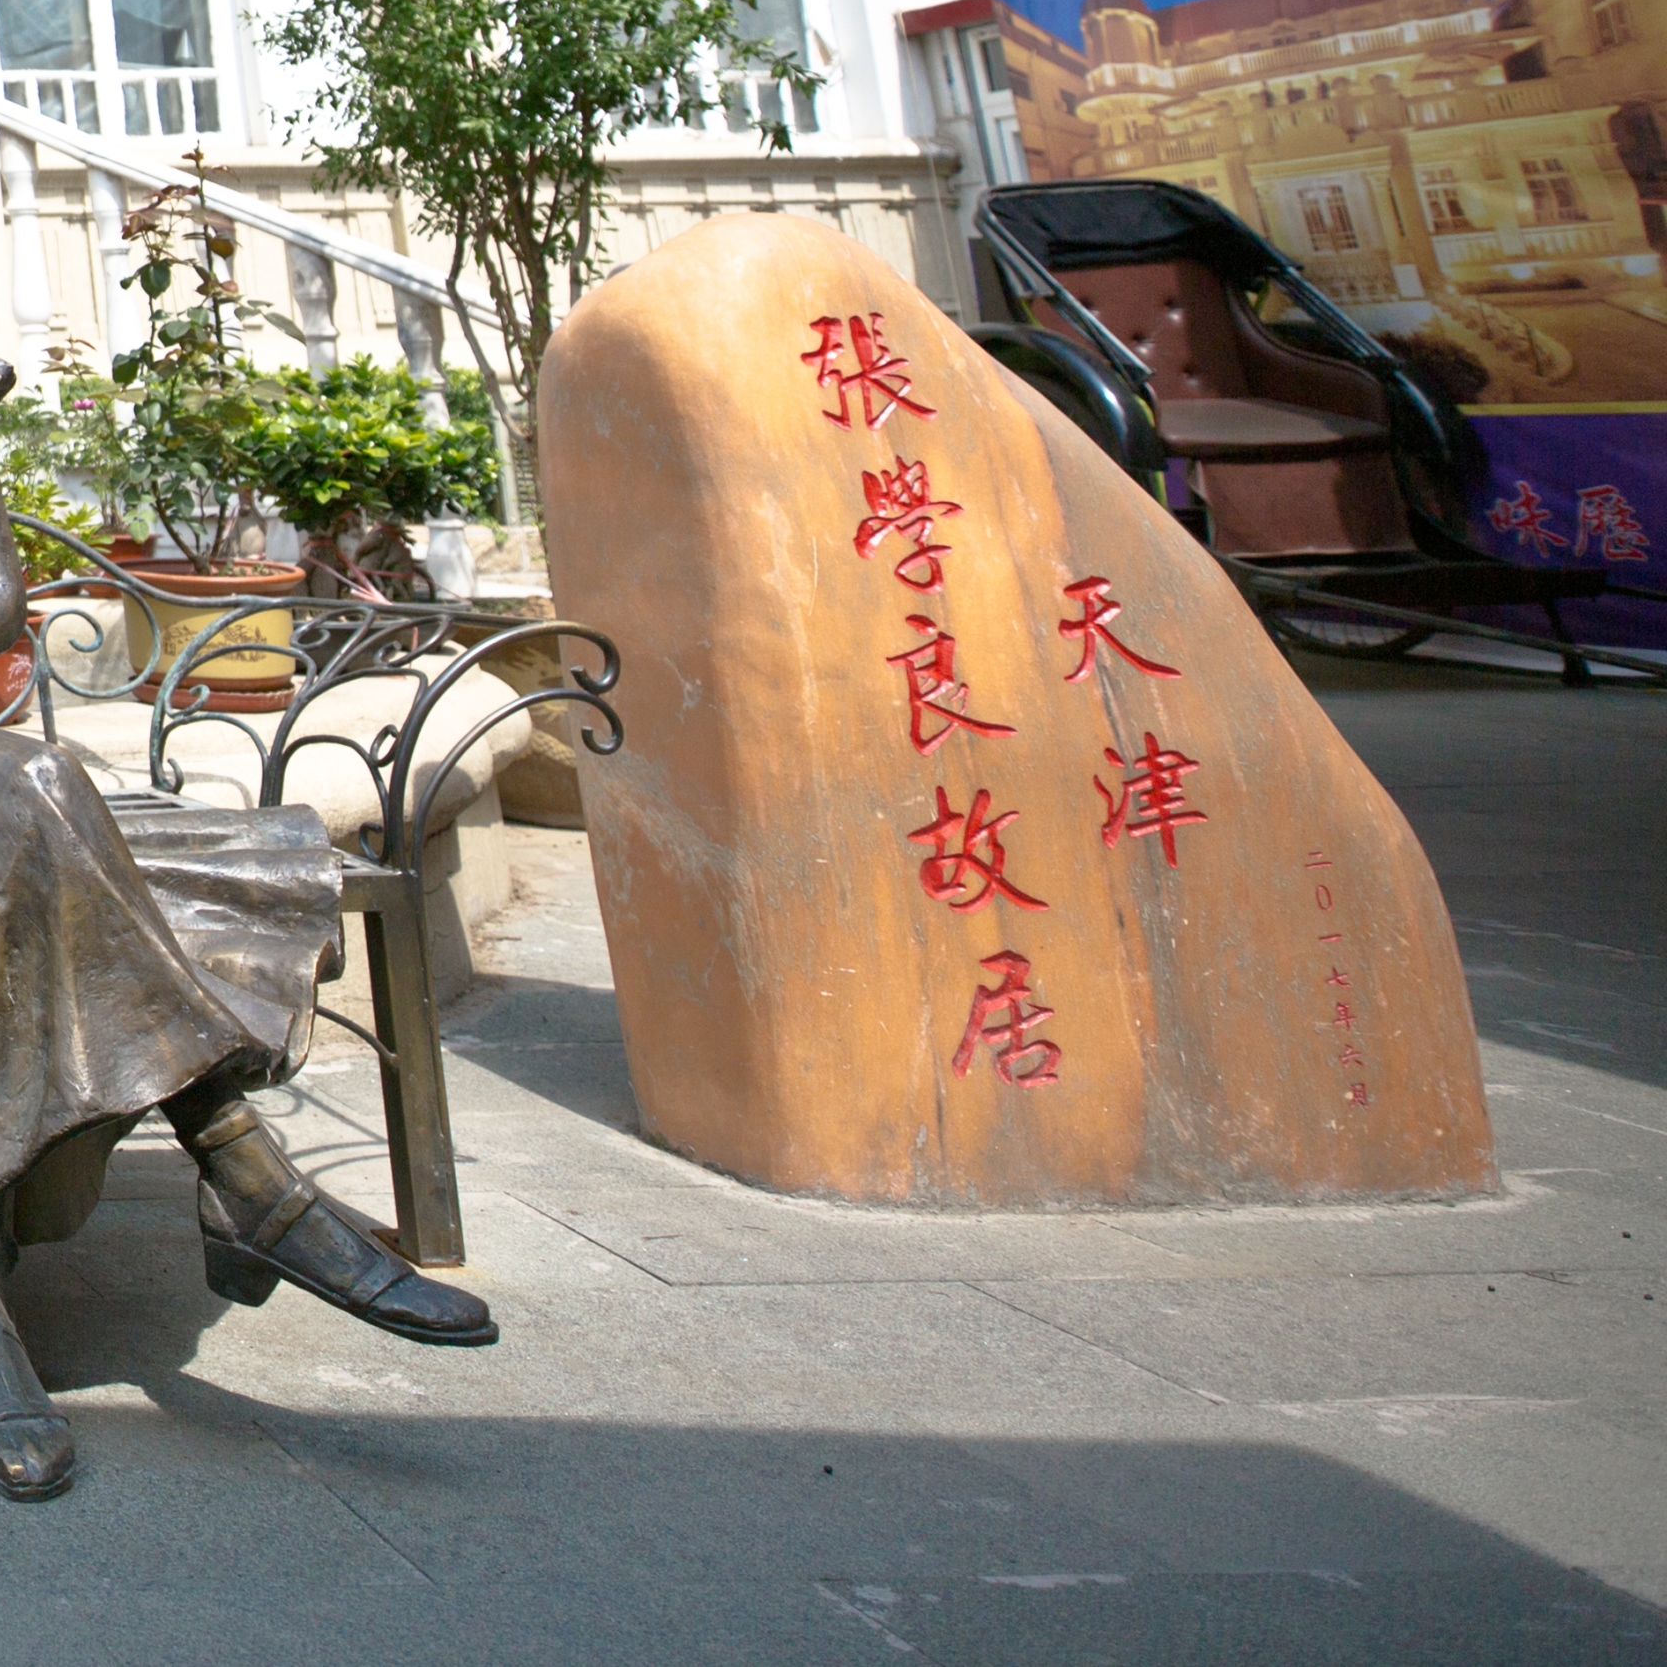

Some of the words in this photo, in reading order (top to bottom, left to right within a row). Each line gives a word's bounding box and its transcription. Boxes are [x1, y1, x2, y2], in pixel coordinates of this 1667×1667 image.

[800, 310, 1063, 1091] 張學良故居
[1057, 574, 1209, 870] 天津
